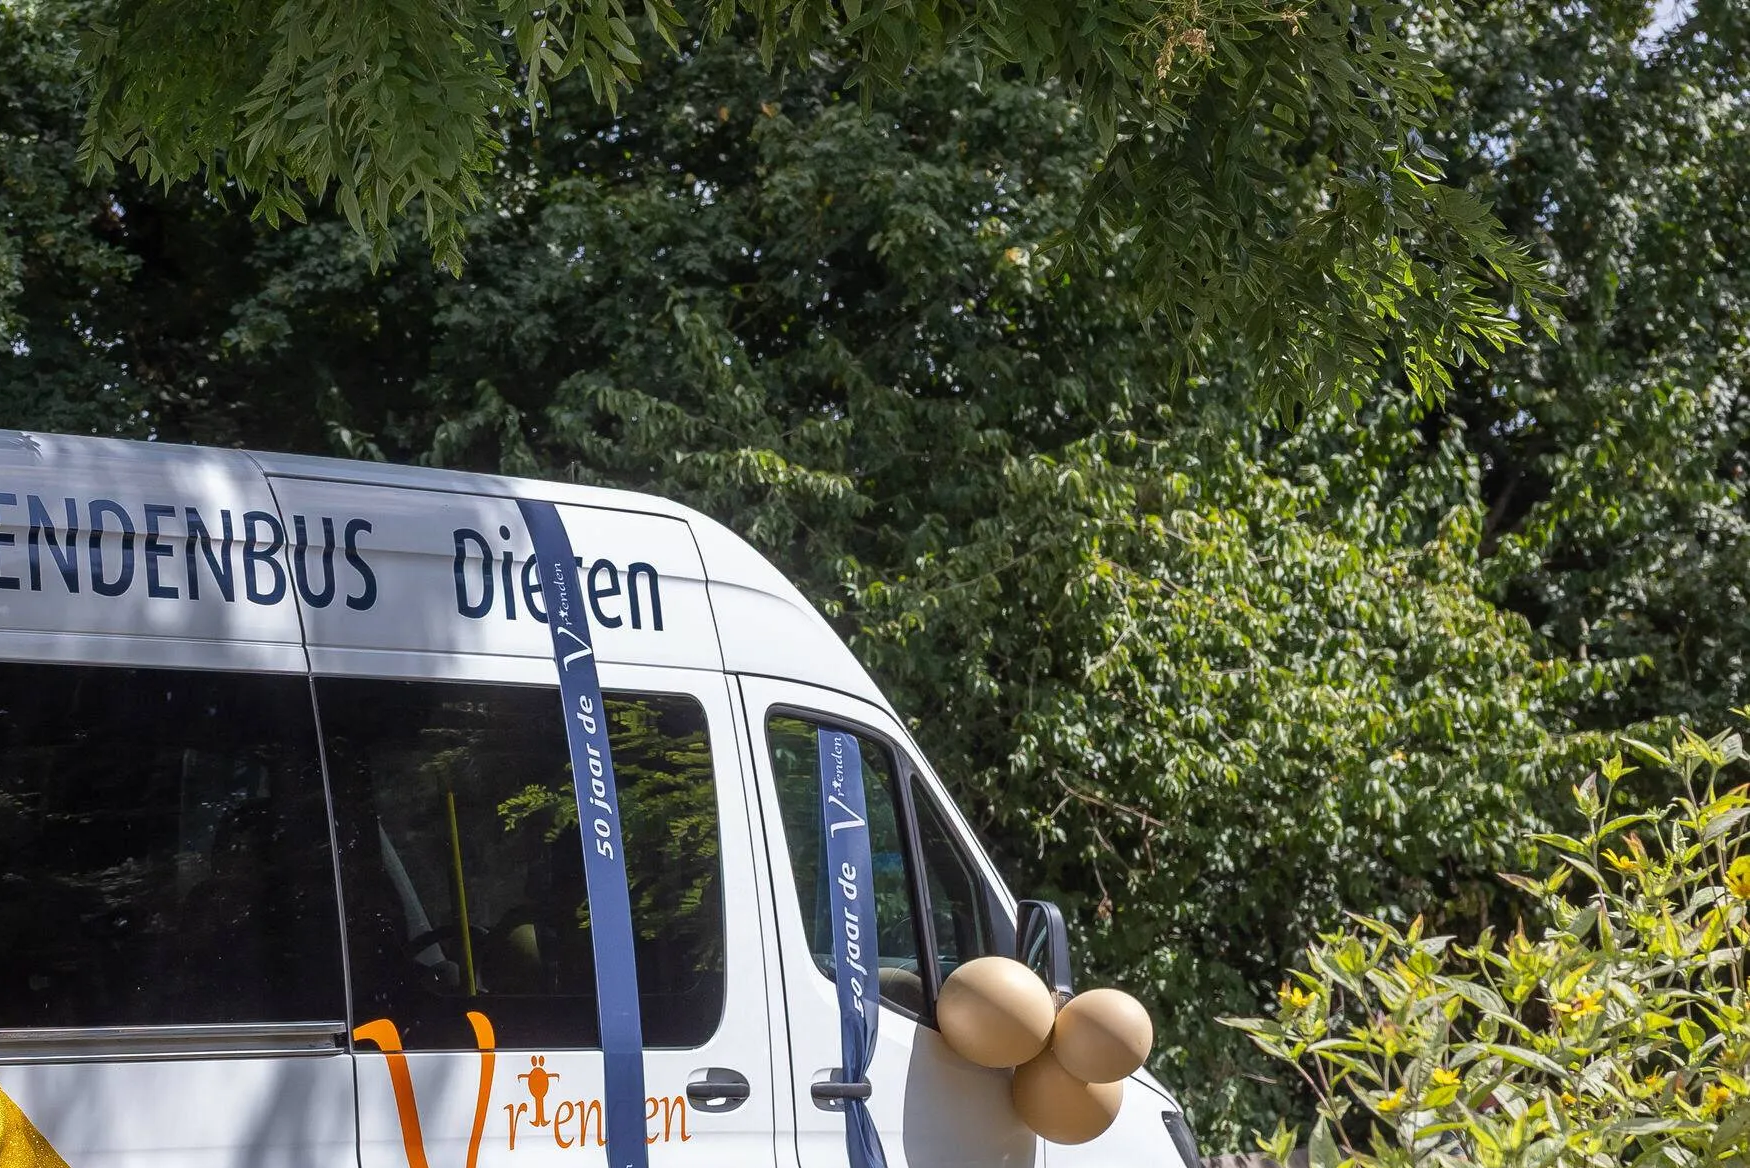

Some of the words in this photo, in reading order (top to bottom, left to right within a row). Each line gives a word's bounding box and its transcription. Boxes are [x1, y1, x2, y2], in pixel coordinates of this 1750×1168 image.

[453, 525, 664, 632] Dieen
[553, 562, 593, 672] Vrienden
[577, 695, 597, 735] de
[586, 743, 612, 815] jaar
[828, 736, 866, 839] Vrienden
[593, 817, 614, 860] 50
[837, 862, 858, 901] de
[844, 906, 868, 976] jaar
[850, 979, 865, 1019] 50
